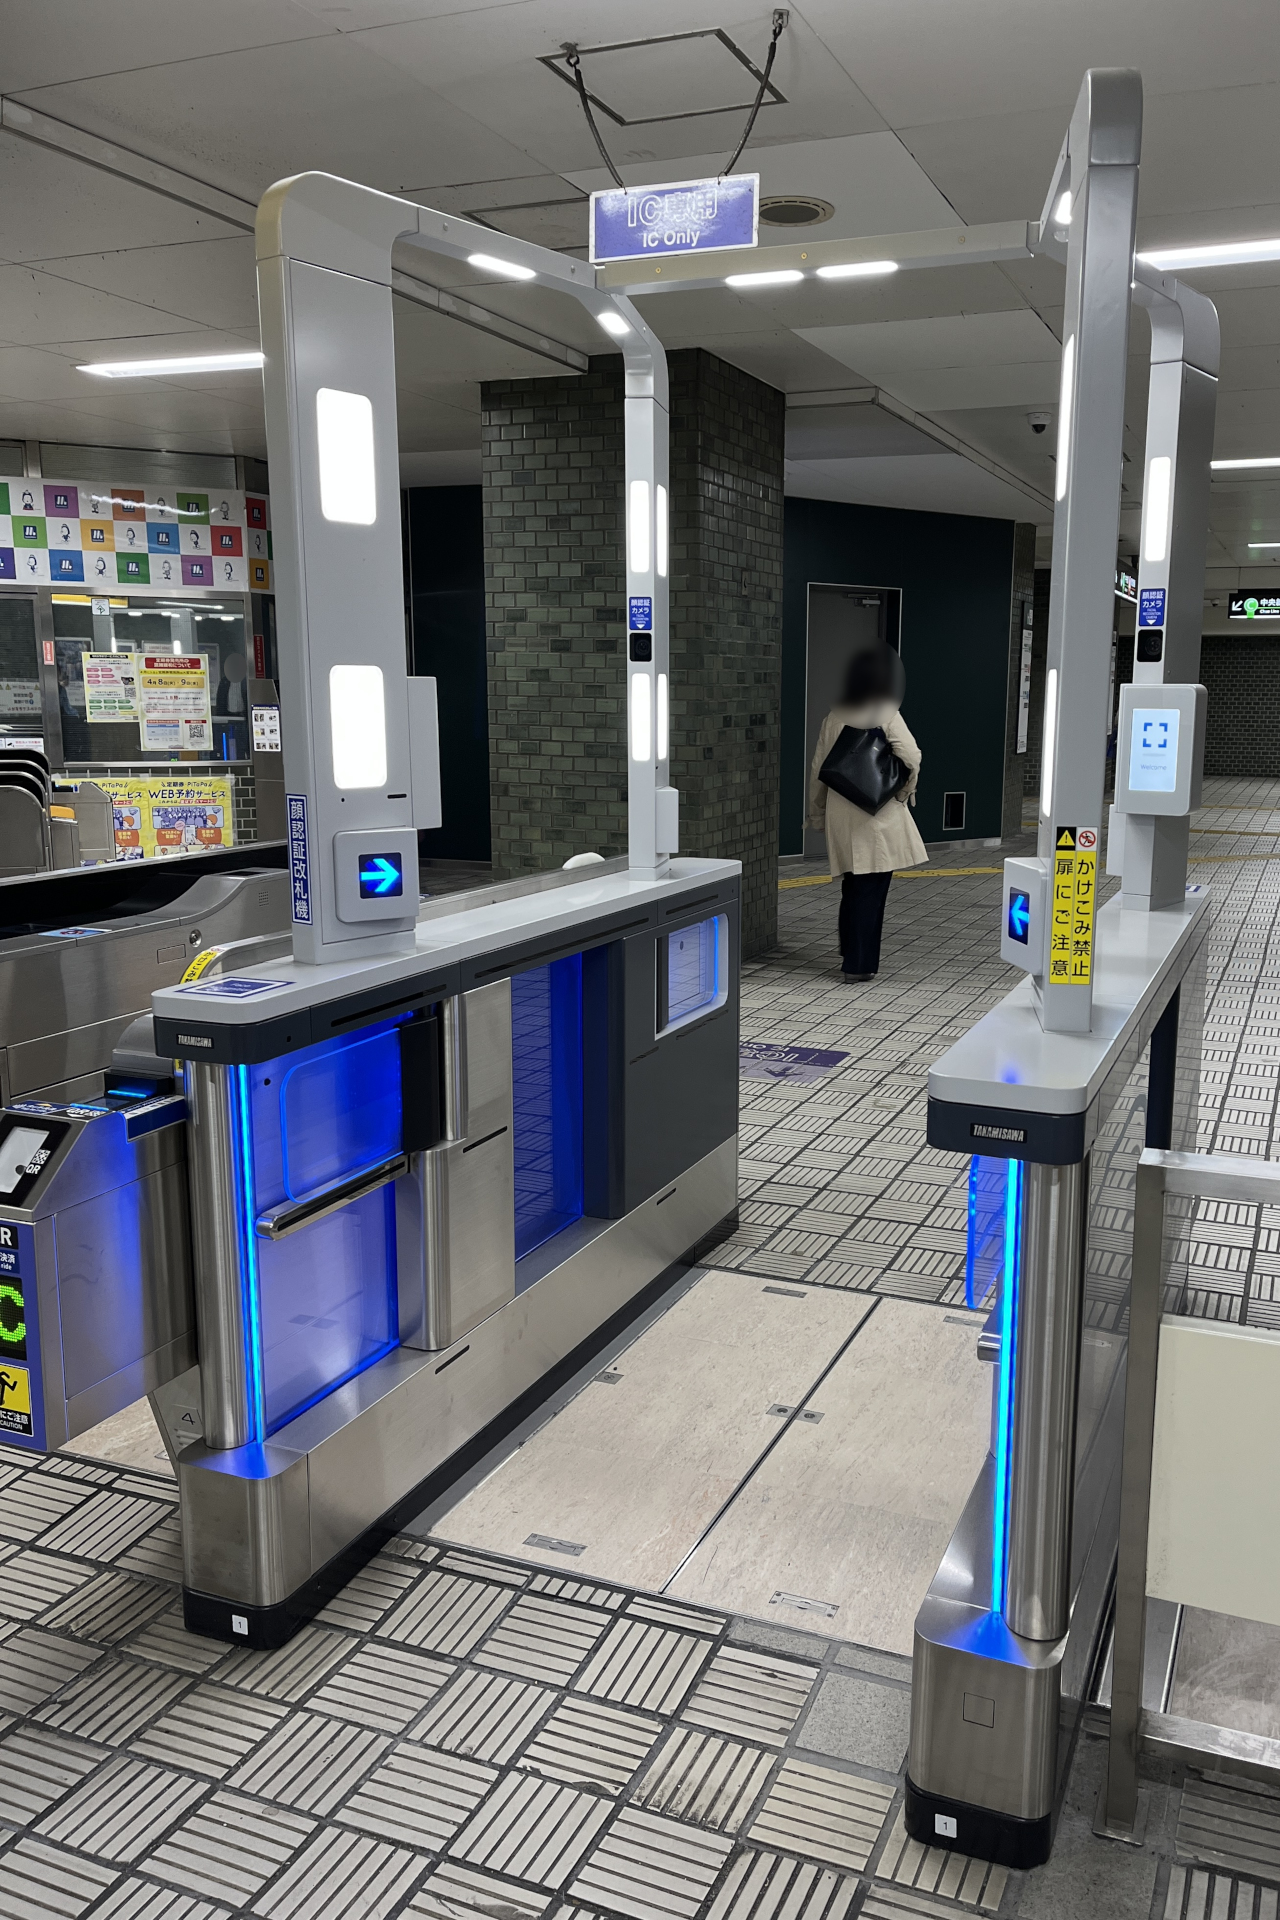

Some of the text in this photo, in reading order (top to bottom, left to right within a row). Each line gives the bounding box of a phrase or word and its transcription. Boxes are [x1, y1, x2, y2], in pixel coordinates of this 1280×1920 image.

[627, 188, 718, 227] IC専用
[642, 229, 701, 248] IC Only
[1142, 591, 1164, 599] 顔認証
[630, 598, 651, 606] 顔認証
[1142, 600, 1163, 608] カメラ
[148, 788, 226, 799] WEB予約サービス
[290, 801, 309, 919] 顔認証改札機
[1051, 858, 1074, 976] 扉にご注意
[1071, 859, 1095, 977] かけこみ禁止
[177, 1034, 212, 1048] TAKAMISAWA
[973, 1124, 1024, 1142] TAKAMISAWA
[25, 1164, 42, 1175] QR
[0, 1420, 23, 1430] CAUTION
[943, 1821, 948, 1831] 1
